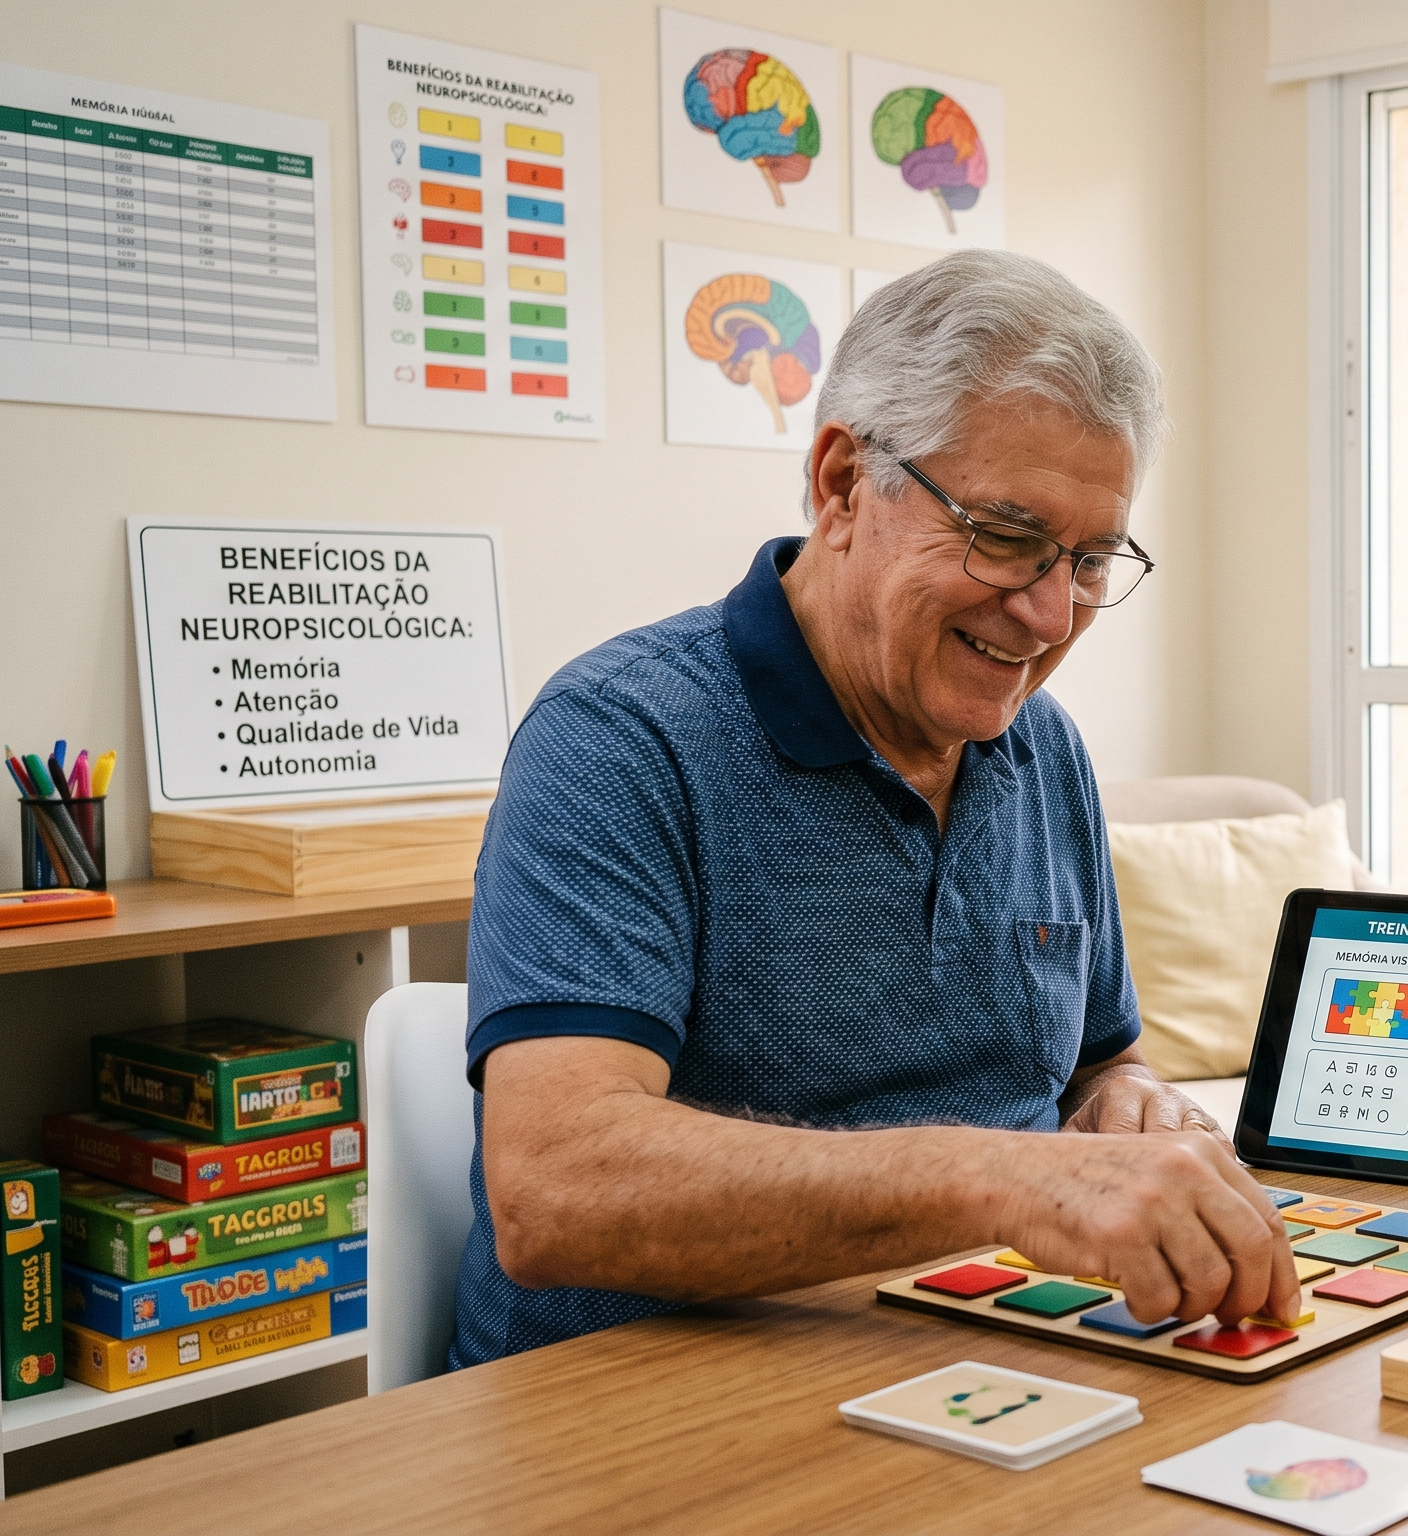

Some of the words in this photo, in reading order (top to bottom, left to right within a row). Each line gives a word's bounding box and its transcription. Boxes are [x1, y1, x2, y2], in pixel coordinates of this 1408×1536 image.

[465, 74, 483, 88] DA
[486, 77, 575, 105] REABILITAÇÃO
[71, 97, 128, 115] MEMÓRIA
[220, 542, 385, 571] BENEFÍCIOS
[394, 551, 430, 572] DA
[228, 578, 429, 611] REABILITAÇÃO
[180, 611, 474, 641] NEUROPSICOLÓGICA:
[231, 656, 341, 680] Memória
[236, 718, 364, 745] Qualidade
[372, 717, 401, 738] de
[408, 715, 459, 737] Vida
[239, 750, 377, 778] Autonomia
[1335, 951, 1388, 964] MEMÓRIA
[1326, 1060, 1337, 1073] A
[1321, 1082, 1334, 1095] A
[1342, 1084, 1354, 1096] C
[1361, 1085, 1374, 1098] R
[235, 1141, 323, 1175] TAGROLS
[208, 1194, 325, 1238] TACGROLS
